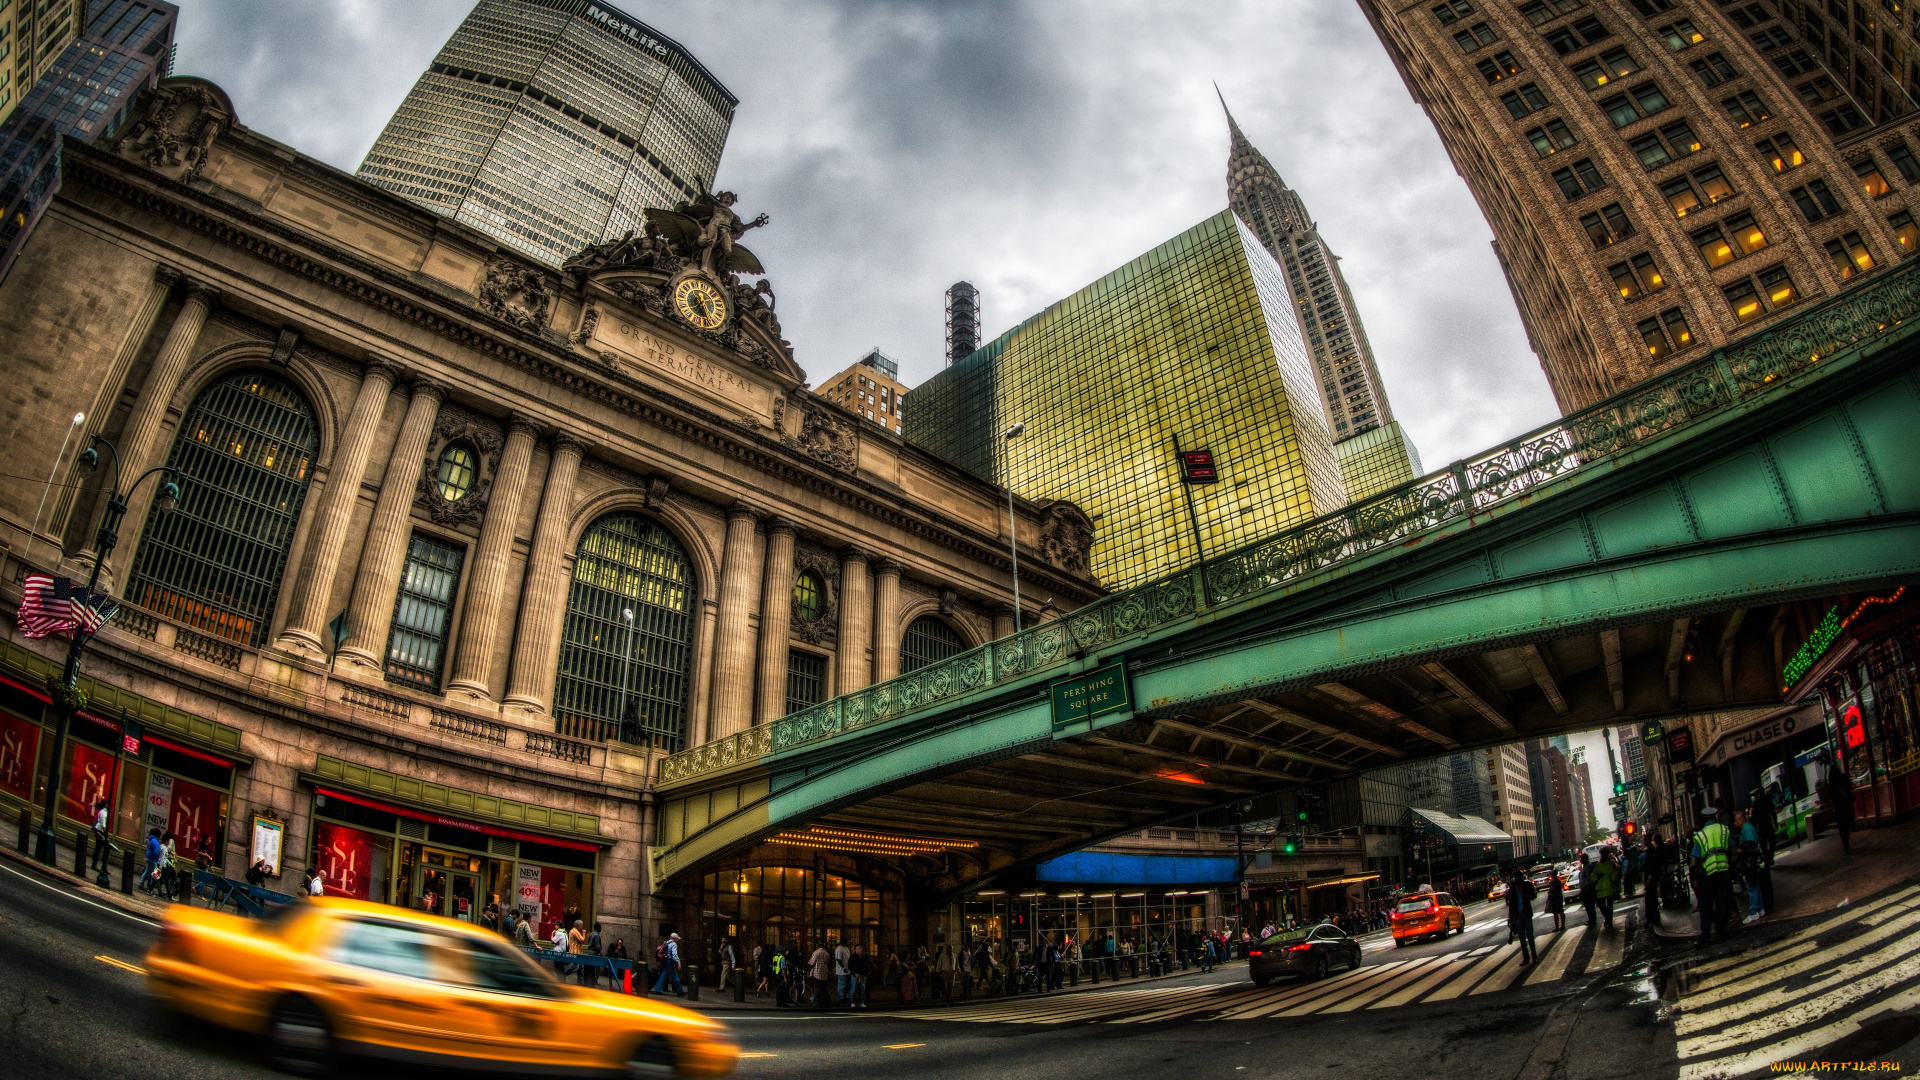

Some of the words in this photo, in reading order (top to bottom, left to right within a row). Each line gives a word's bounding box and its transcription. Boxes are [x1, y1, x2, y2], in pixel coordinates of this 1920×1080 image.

[586, 4, 668, 56] MetLife
[620, 324, 675, 355] GRAND
[686, 354, 754, 394] CENTRAL
[648, 348, 725, 392] TERMINAL
[1063, 677, 1114, 699] PERSHING
[1070, 692, 1109, 710] SQUARE
[1734, 722, 1782, 751] CHASE
[152, 773, 172, 787] NEW
[149, 795, 170, 810] 40%
[147, 813, 168, 826] NEW
[520, 867, 540, 878] NEW
[519, 887, 539, 898] 40%
[518, 903, 538, 913] NEW
